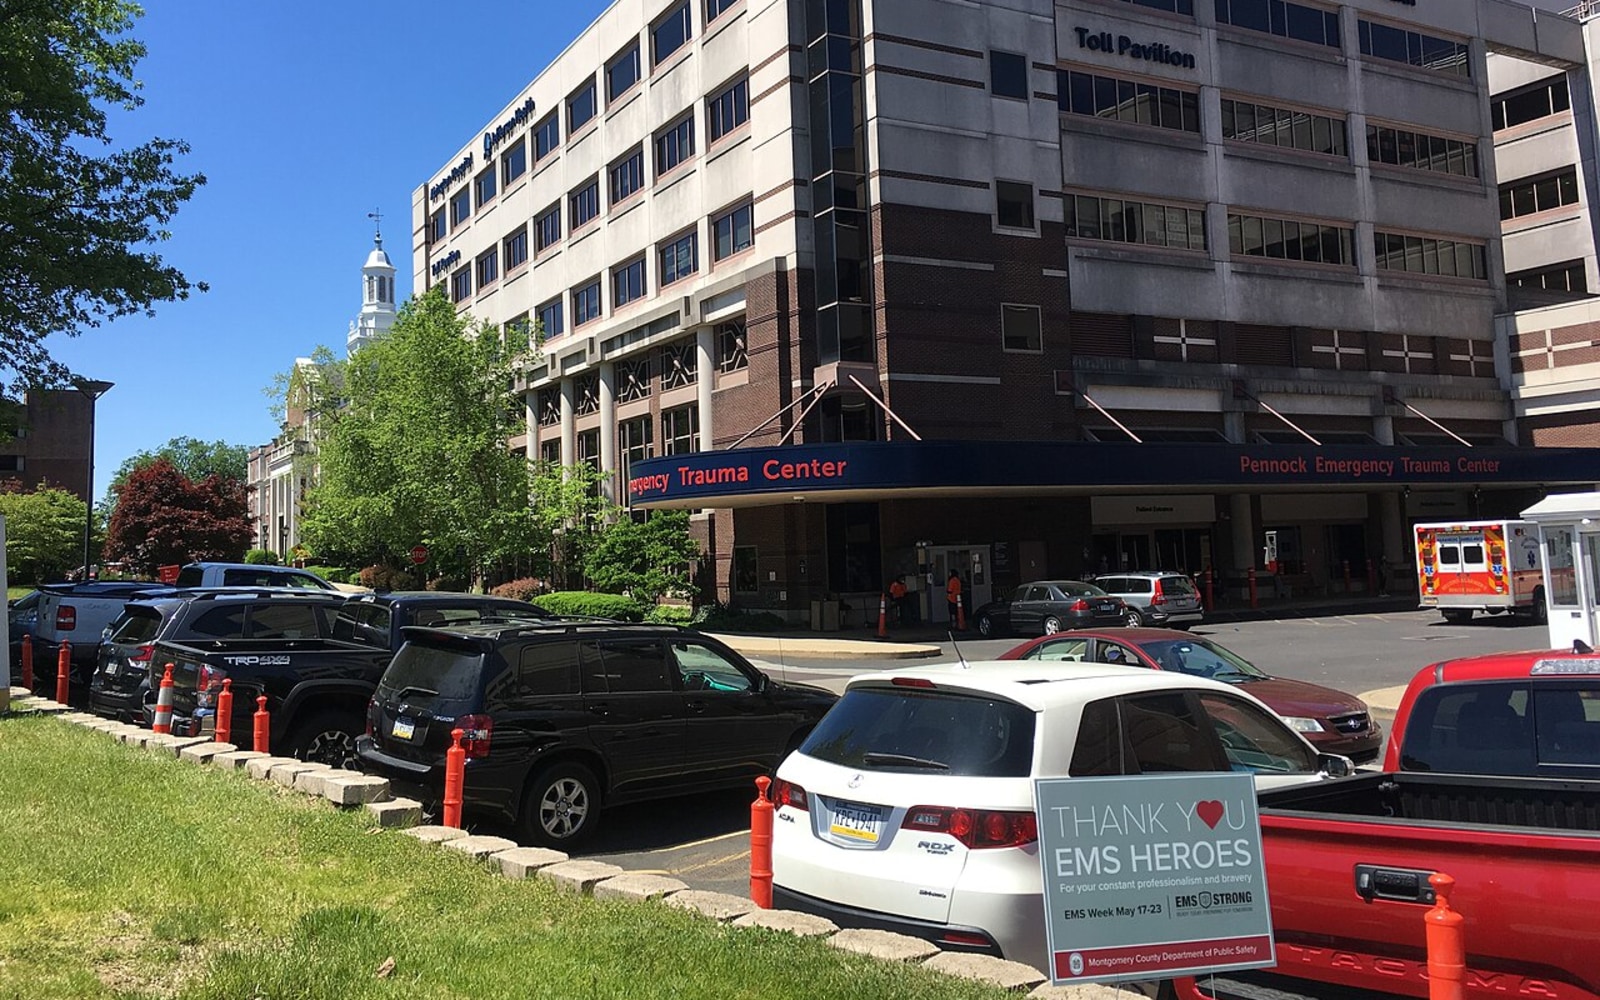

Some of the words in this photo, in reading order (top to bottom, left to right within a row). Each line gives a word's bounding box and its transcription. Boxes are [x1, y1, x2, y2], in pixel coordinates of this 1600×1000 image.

[1074, 26, 1114, 53] Toll
[1118, 35, 1195, 69] Pavilion
[678, 465, 749, 487] Trauma
[763, 458, 848, 481] Center
[1240, 455, 1307, 474] Pennock
[1315, 456, 1394, 477] Emergency
[1400, 456, 1450, 473] Trauma
[1457, 457, 1500, 473] Center
[223, 656, 259, 666] TRD
[1051, 802, 1168, 838] THANK
[917, 841, 956, 852] RDX
[1055, 845, 1121, 877] EMS
[1131, 839, 1252, 873] HEROES
[1060, 883, 1075, 893] For
[1077, 882, 1096, 895] your
[1098, 879, 1136, 891] constant
[1137, 875, 1202, 891] professionalism
[1204, 875, 1220, 885] and
[1221, 873, 1252, 886] bravery
[1175, 895, 1198, 908] EMS
[1213, 890, 1252, 905] STRONG
[1064, 909, 1086, 920] EMS
[1087, 907, 1114, 919] Week
[1116, 905, 1136, 919] May
[1137, 904, 1162, 915] 17-23
[1088, 956, 1135, 968] Montgomery
[1135, 953, 1161, 963] County
[1162, 950, 1204, 962] Department
[1205, 948, 1213, 957] of
[1213, 946, 1235, 957] Public
[1236, 944, 1257, 955] Safety
[1289, 944, 1558, 998] TACMA
